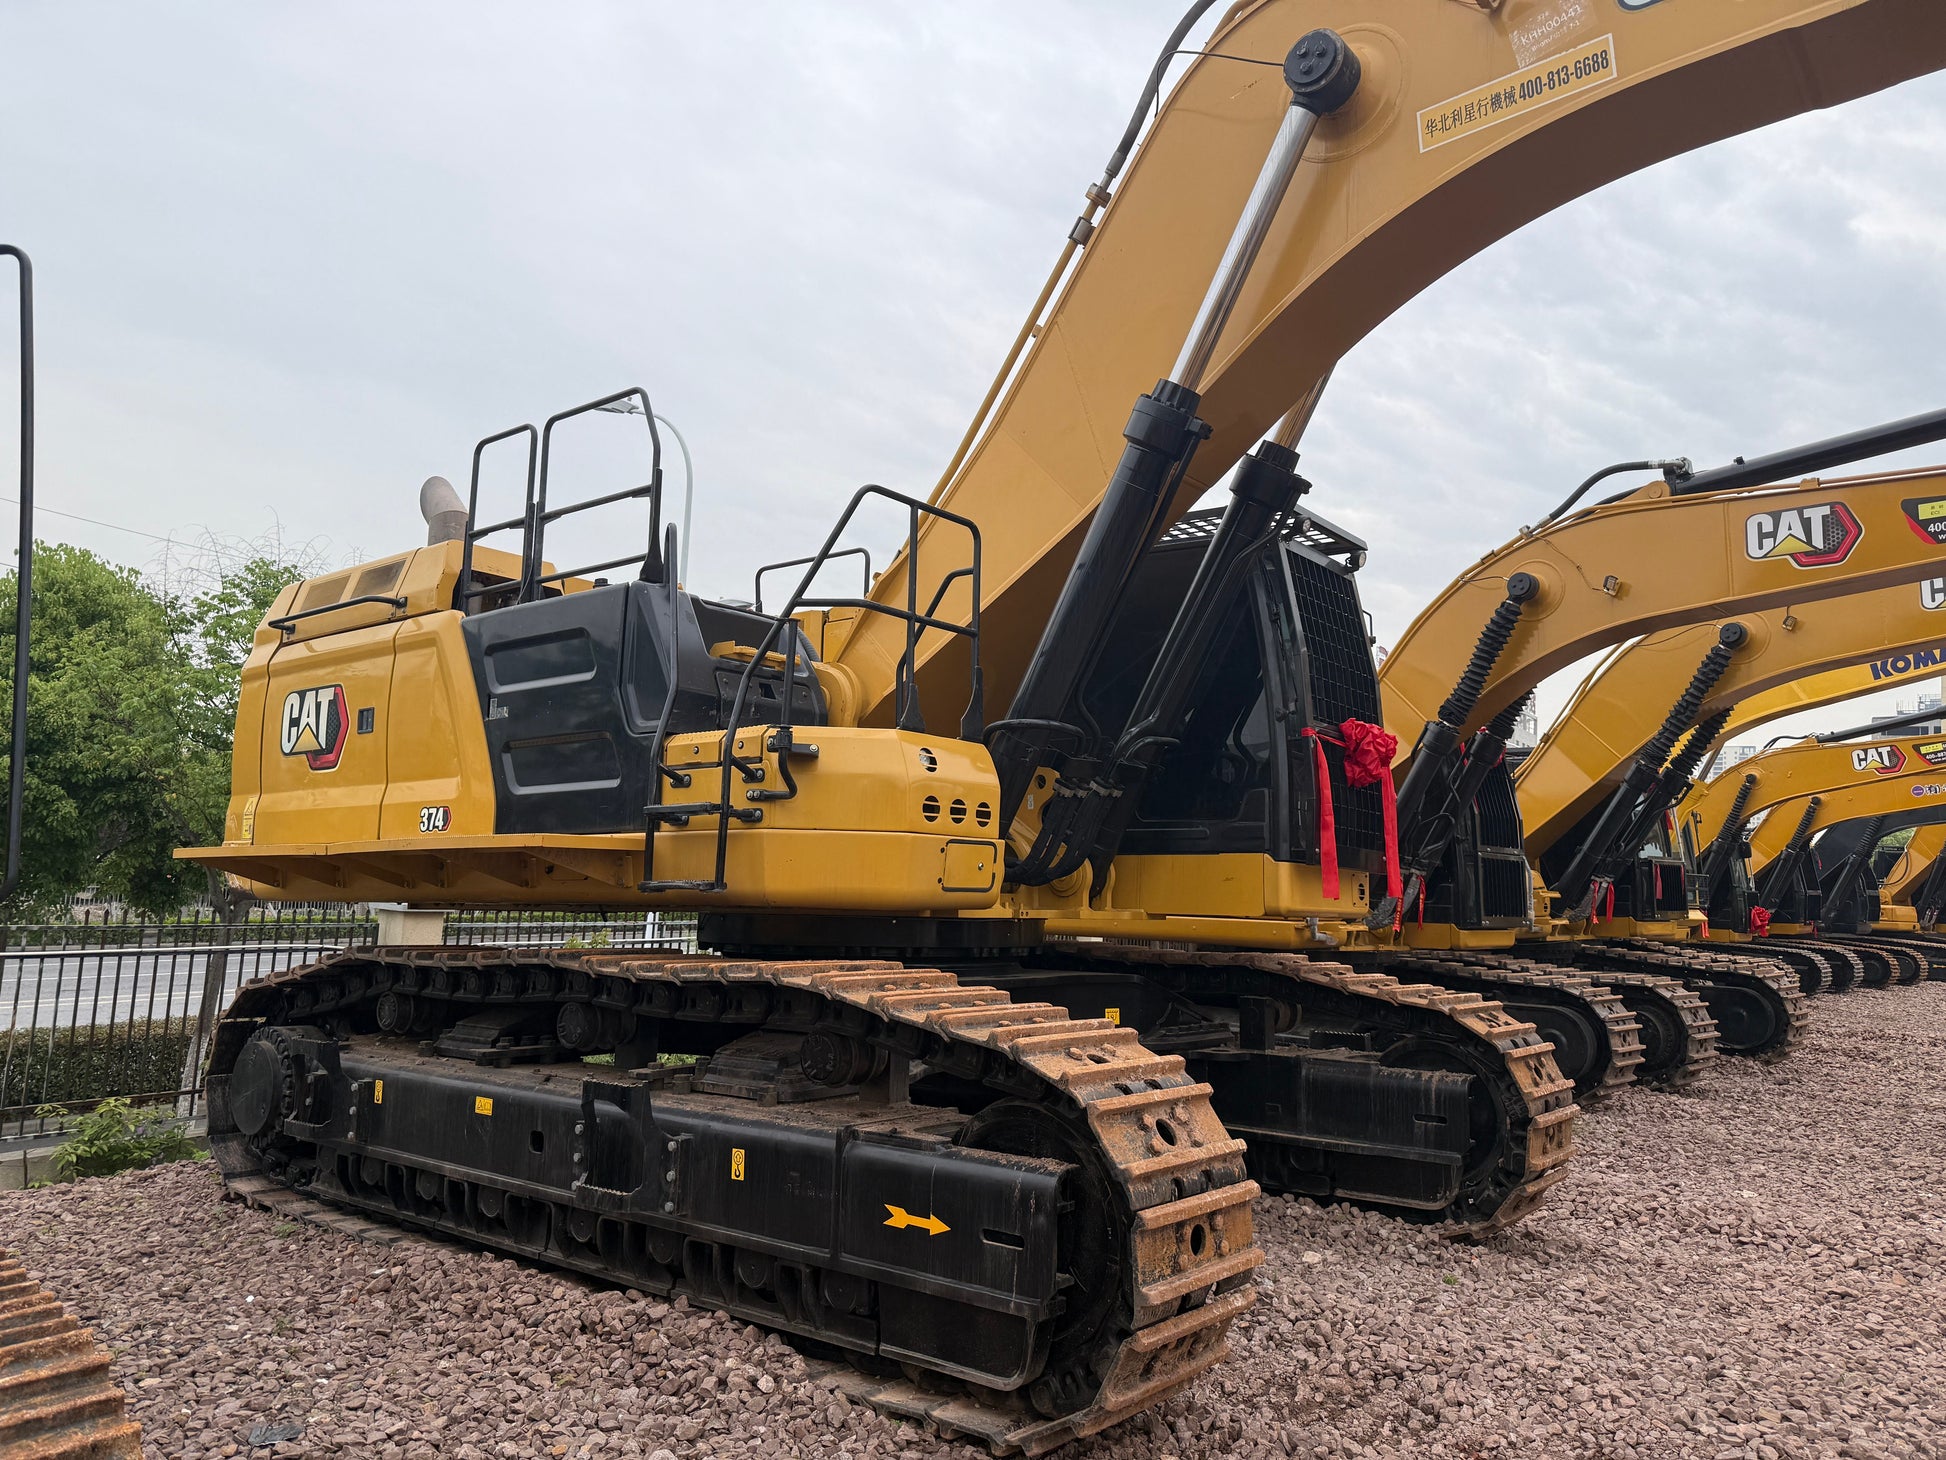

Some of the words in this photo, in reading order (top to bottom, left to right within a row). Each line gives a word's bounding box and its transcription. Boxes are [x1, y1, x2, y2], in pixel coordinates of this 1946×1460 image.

[1425, 86, 1518, 139] 华北利星行機械
[1518, 49, 1609, 101] 400-813-6688
[1747, 505, 1830, 558] CAT
[1870, 647, 1946, 681] KOM
[281, 687, 335, 754] CAT
[1851, 746, 1891, 770] CAT
[420, 807, 444, 832] 374
